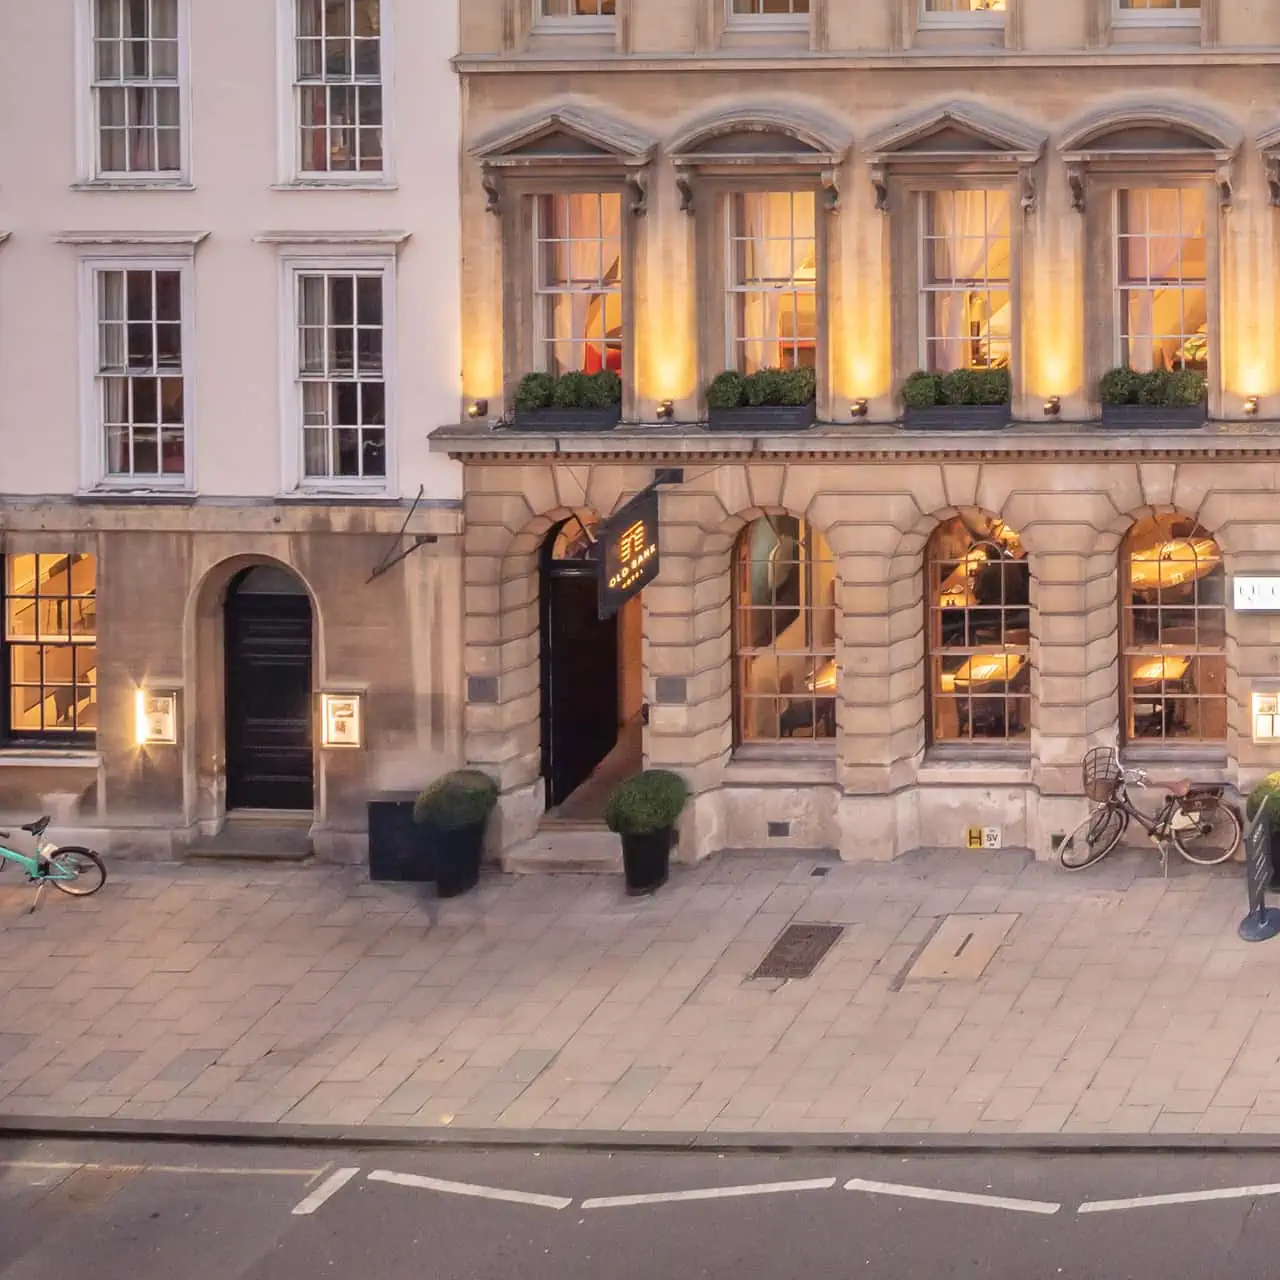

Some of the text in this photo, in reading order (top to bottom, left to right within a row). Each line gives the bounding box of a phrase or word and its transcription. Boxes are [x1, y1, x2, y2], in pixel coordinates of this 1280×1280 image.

[608, 543, 656, 588] OLD BANK
[969, 829, 982, 847] H
